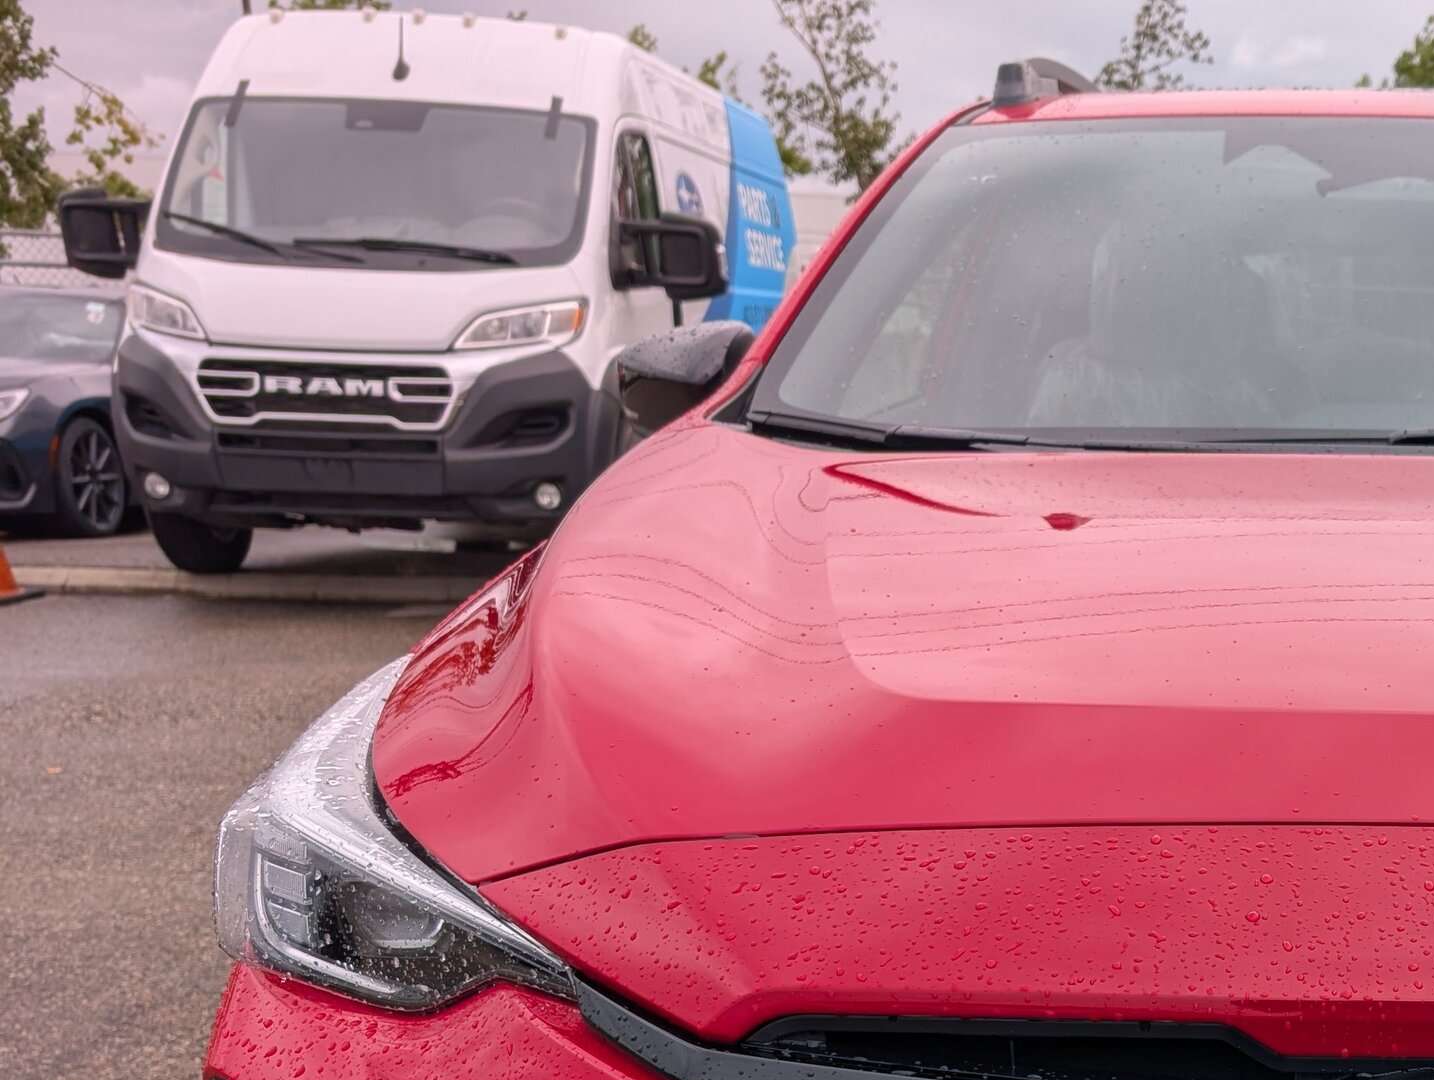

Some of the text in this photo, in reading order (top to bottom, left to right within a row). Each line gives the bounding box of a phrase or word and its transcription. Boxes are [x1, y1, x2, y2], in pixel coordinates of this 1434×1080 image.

[736, 182, 771, 227] PARTS
[745, 228, 786, 272] SERVICE
[264, 375, 385, 397] RAM
